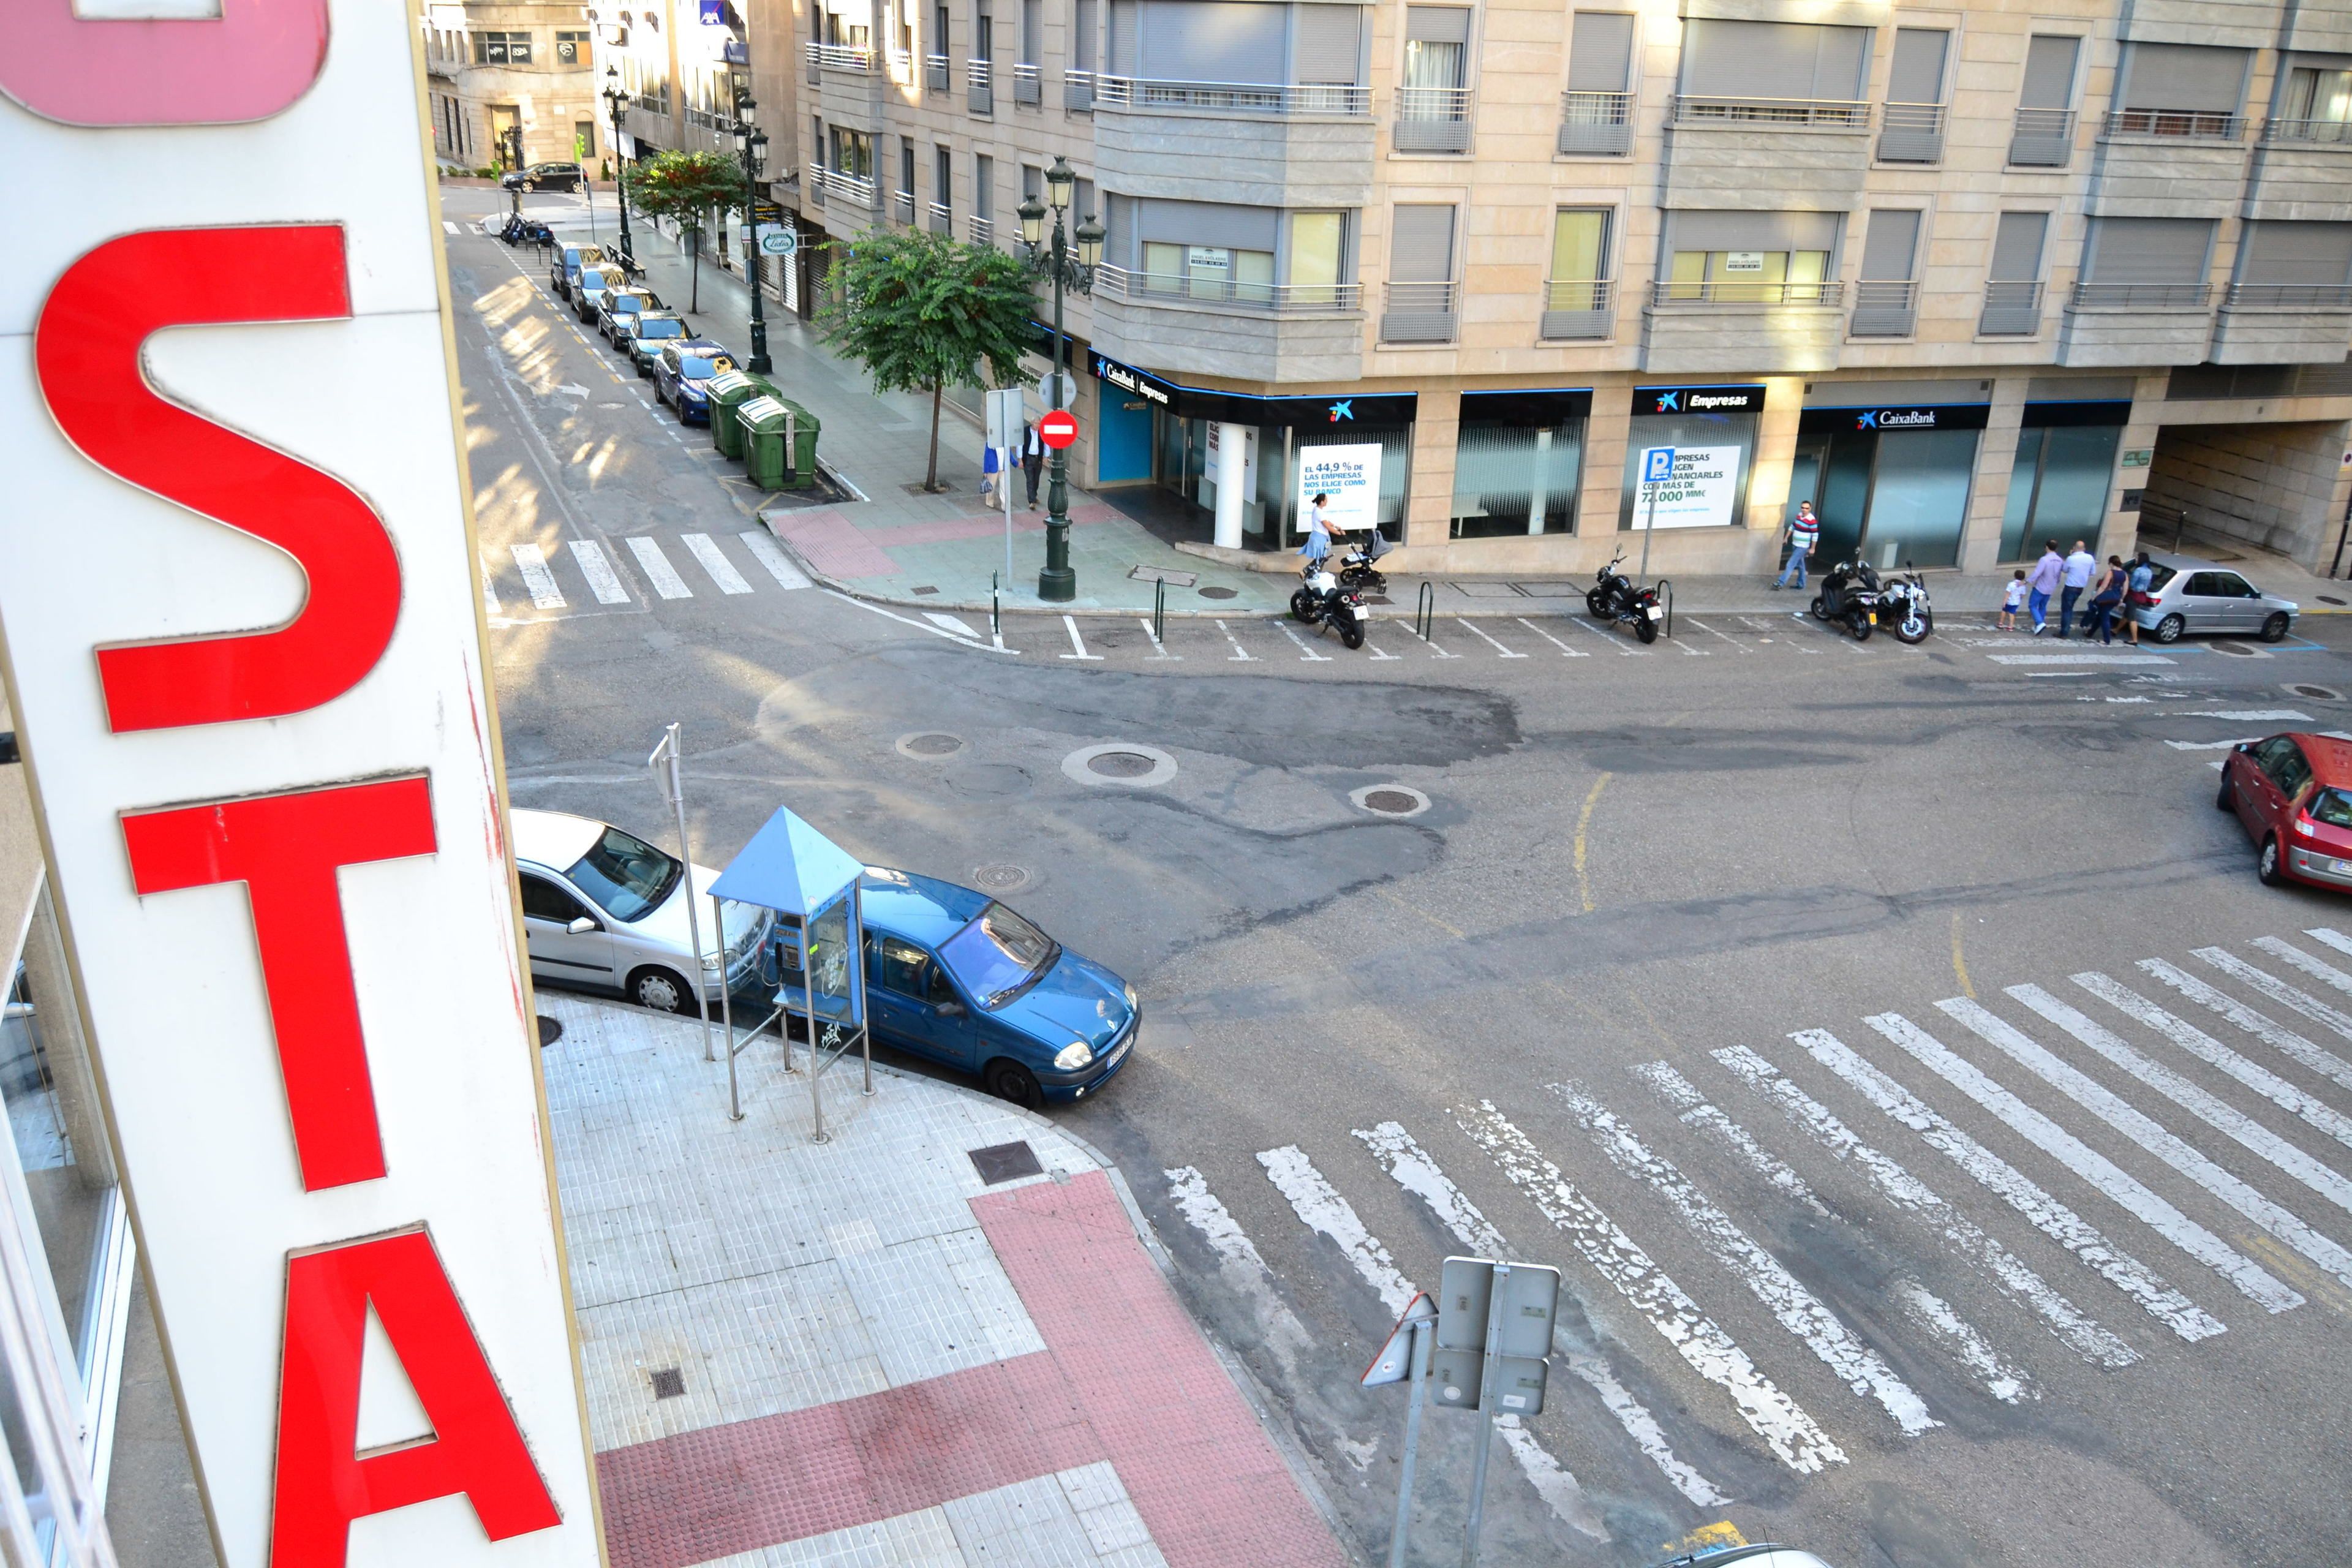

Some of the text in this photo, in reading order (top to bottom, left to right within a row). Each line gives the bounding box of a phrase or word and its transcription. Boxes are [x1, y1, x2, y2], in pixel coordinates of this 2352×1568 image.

[700, 12, 720, 24] AXA
[1107, 363, 1168, 404] CaixaBank Empresas
[1690, 394, 1748, 409] Empresas
[1880, 411, 1935, 424] CaixaBank
[1316, 462, 1340, 473] 44,9
[1342, 462, 1352, 471] %
[1649, 452, 1669, 479] P
[1672, 471, 1723, 480] NANCIARLES
[1662, 481, 1681, 489] MÁS
